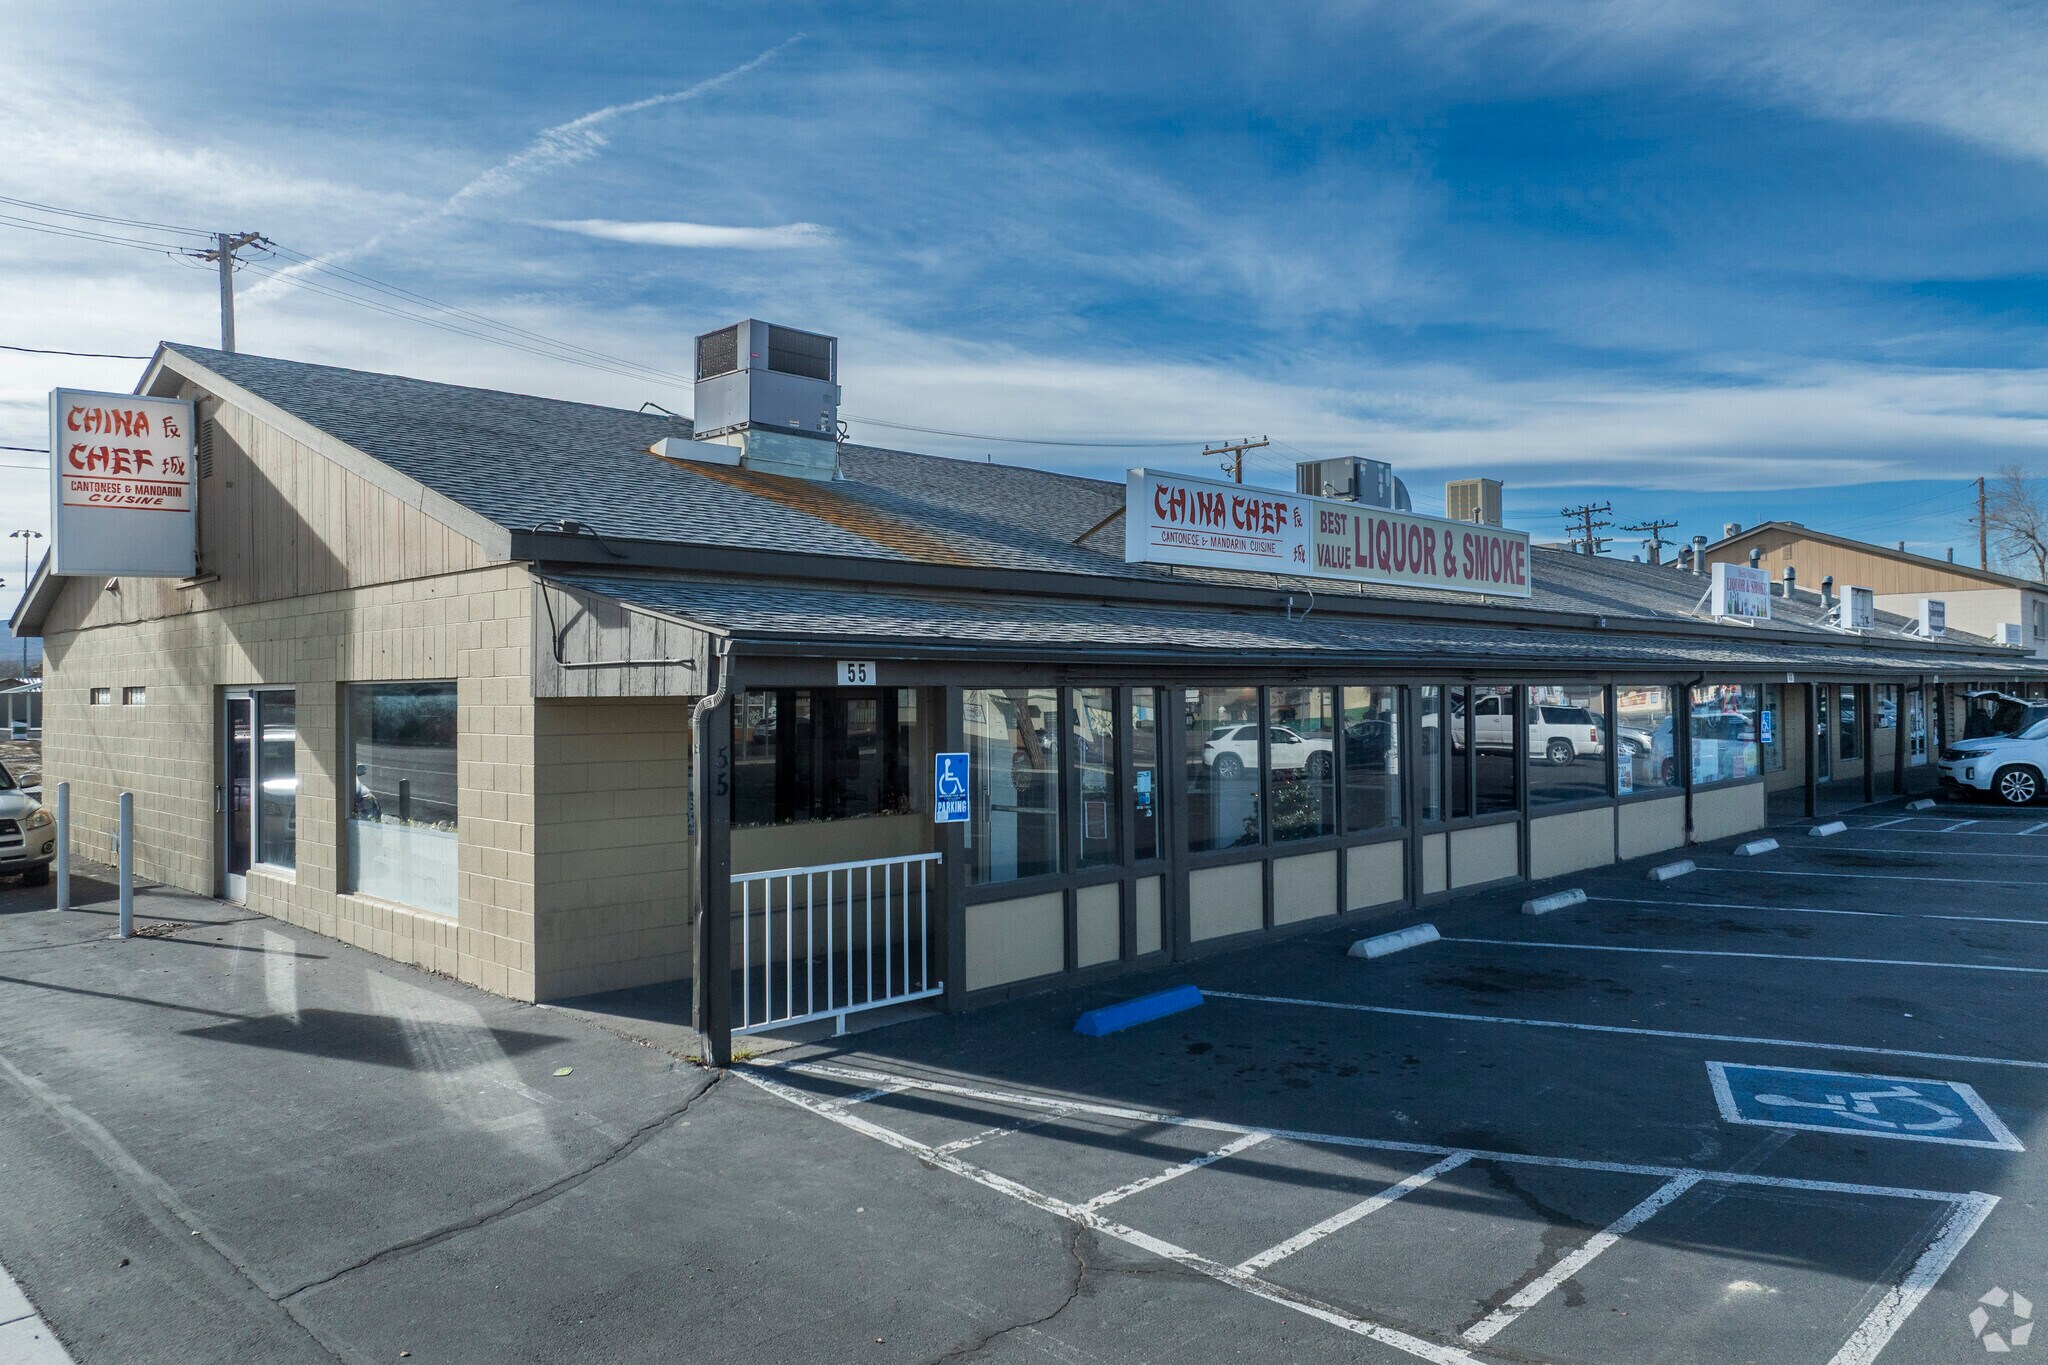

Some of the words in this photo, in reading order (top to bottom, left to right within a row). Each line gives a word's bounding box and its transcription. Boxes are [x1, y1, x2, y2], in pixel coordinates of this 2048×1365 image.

[67, 404, 150, 437] CHINA
[68, 443, 154, 475] CHEF
[71, 480, 122, 494] CANTONESE
[125, 485, 132, 494] &
[135, 484, 182, 498] MANDARIN
[88, 493, 164, 506] CUISINE
[1154, 483, 1227, 529] CHINA
[1232, 495, 1287, 535] CHEF
[1320, 511, 1348, 537] BEST
[1161, 531, 1199, 547] CANTONESE
[1201, 539, 1208, 547] &
[1210, 536, 1247, 551] MANDARIN
[1250, 540, 1276, 554] CUISINE
[1354, 516, 1437, 576] LIQUOR
[1443, 534, 1458, 578] &
[1463, 532, 1526, 586] SMOKE
[1317, 544, 1351, 570] VALUE
[1727, 577, 1745, 592] LIQUOR
[1751, 581, 1767, 595] SMOKE
[847, 663, 867, 683] 55
[938, 801, 966, 813] PARKING
